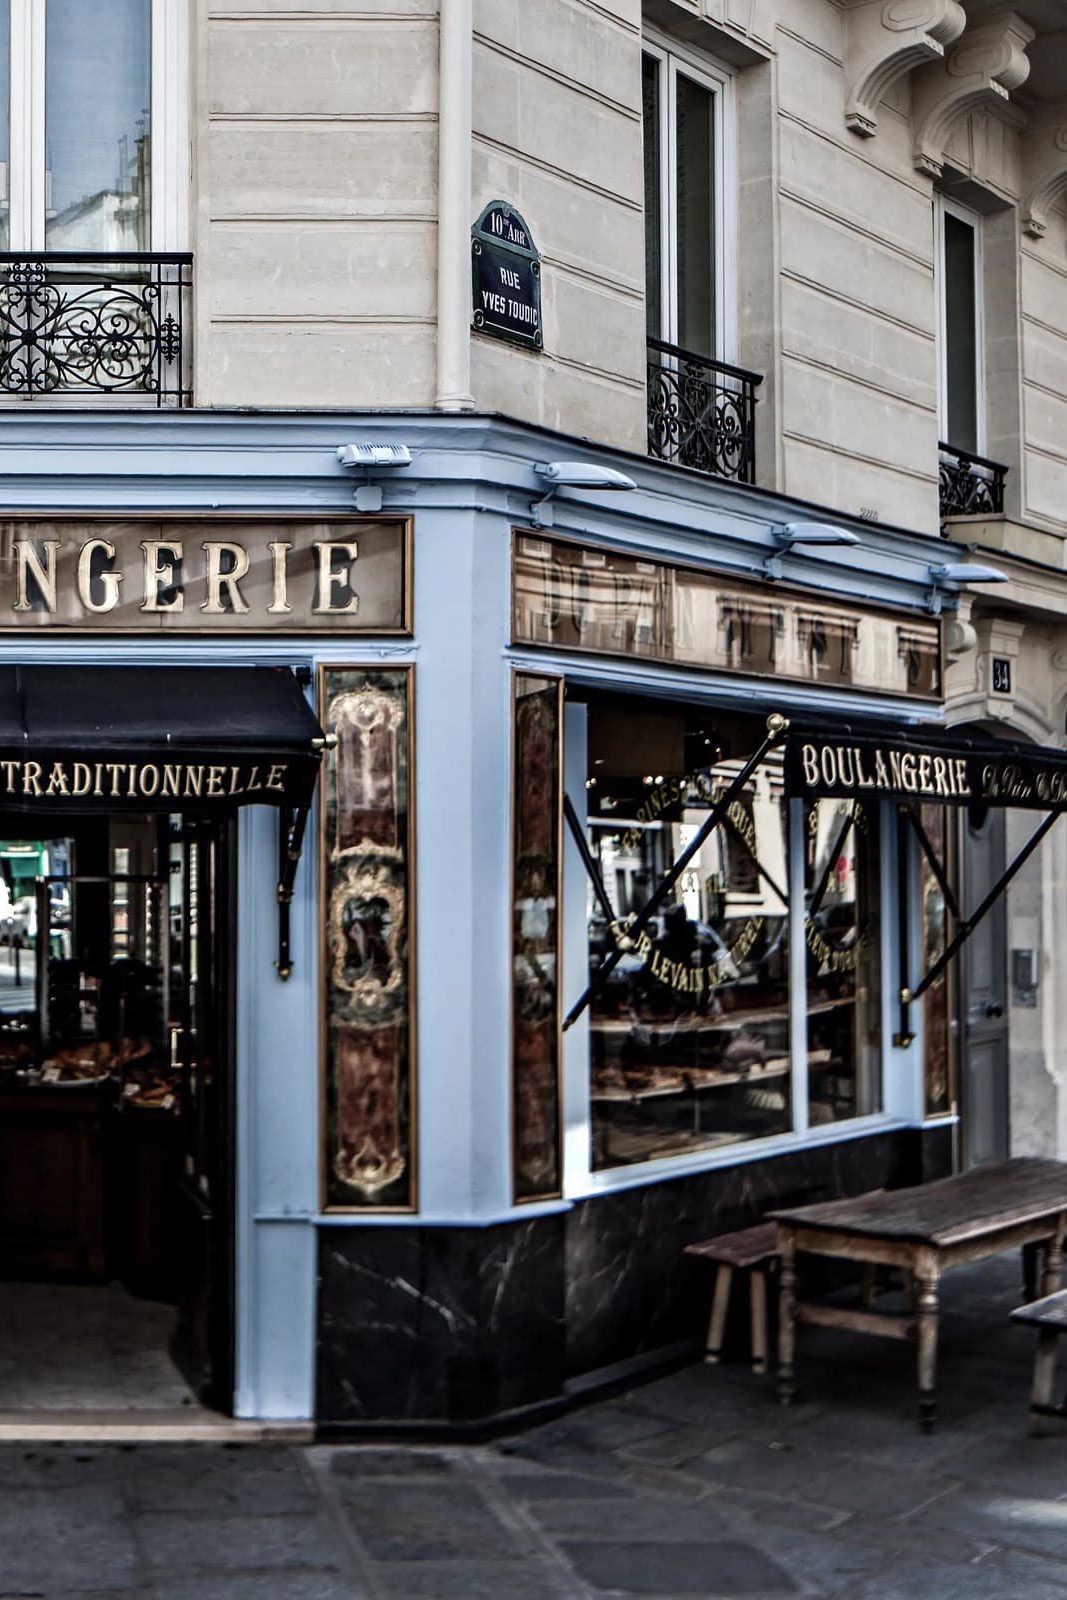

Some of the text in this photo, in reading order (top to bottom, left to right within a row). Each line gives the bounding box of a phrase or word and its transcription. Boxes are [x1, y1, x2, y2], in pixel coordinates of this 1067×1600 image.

[499, 267, 521, 290] RUE
[482, 290, 538, 326] YVES TOUDIC
[995, 661, 1009, 690] 34
[1, 760, 289, 799] TRADITIONNELLE
[802, 743, 972, 798] BOULANGERIE
[649, 948, 705, 994] LEVAIN
